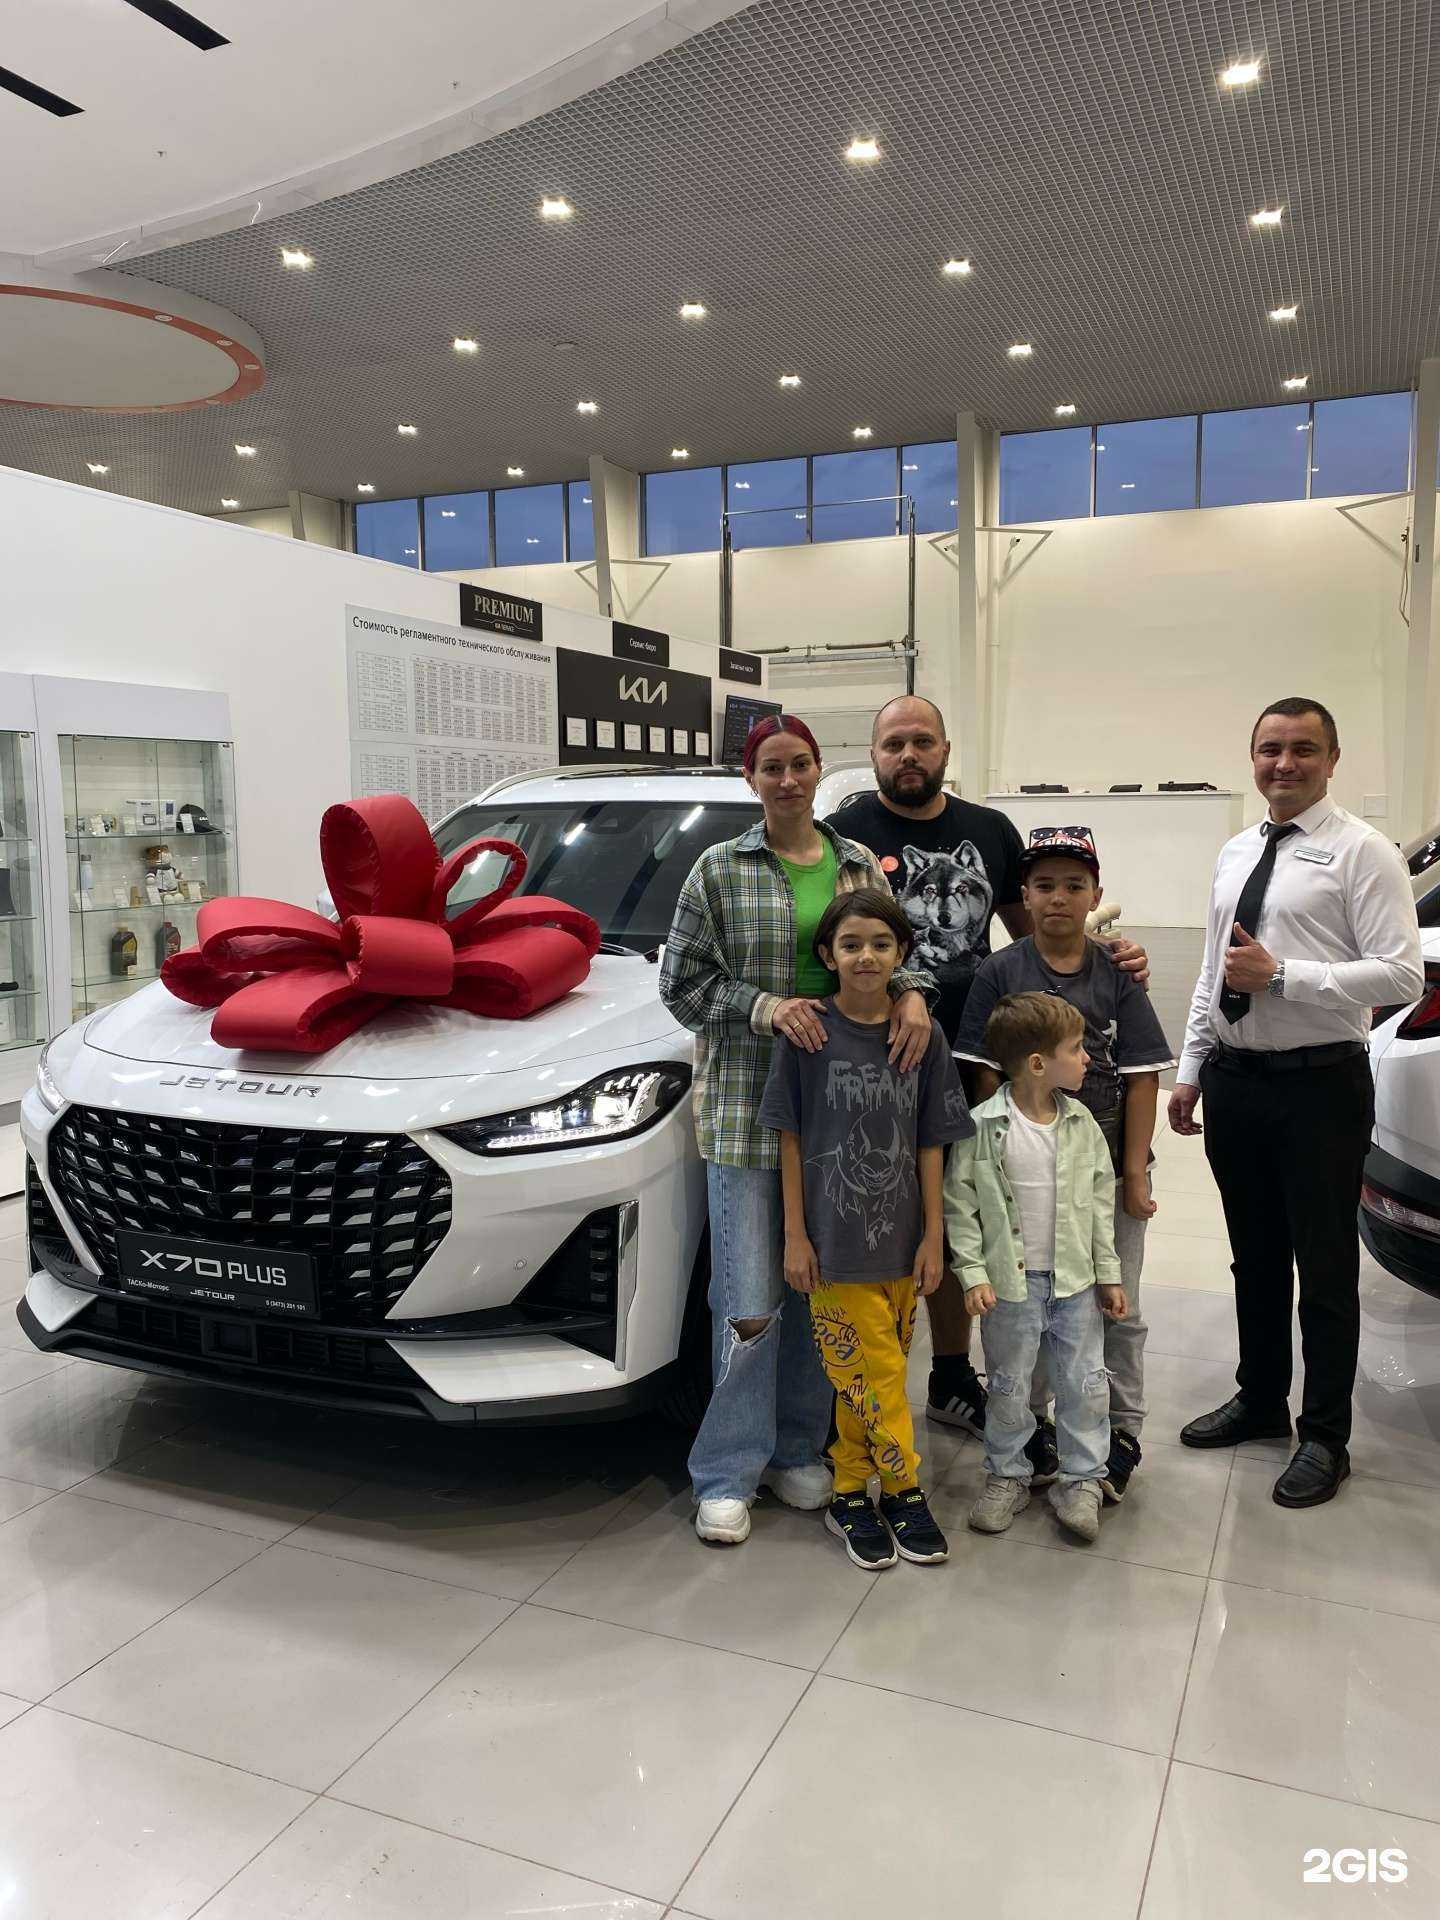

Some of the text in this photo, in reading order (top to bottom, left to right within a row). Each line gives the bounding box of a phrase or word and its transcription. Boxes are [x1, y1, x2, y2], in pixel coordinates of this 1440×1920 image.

[473, 594, 534, 624] PREMIUM
[352, 615, 551, 664] Стоимость регламентного технического обслуживания
[159, 1075, 322, 1098] JETOUR
[139, 1249, 287, 1286] X70 PLUS
[190, 1288, 236, 1301] JETOUR
